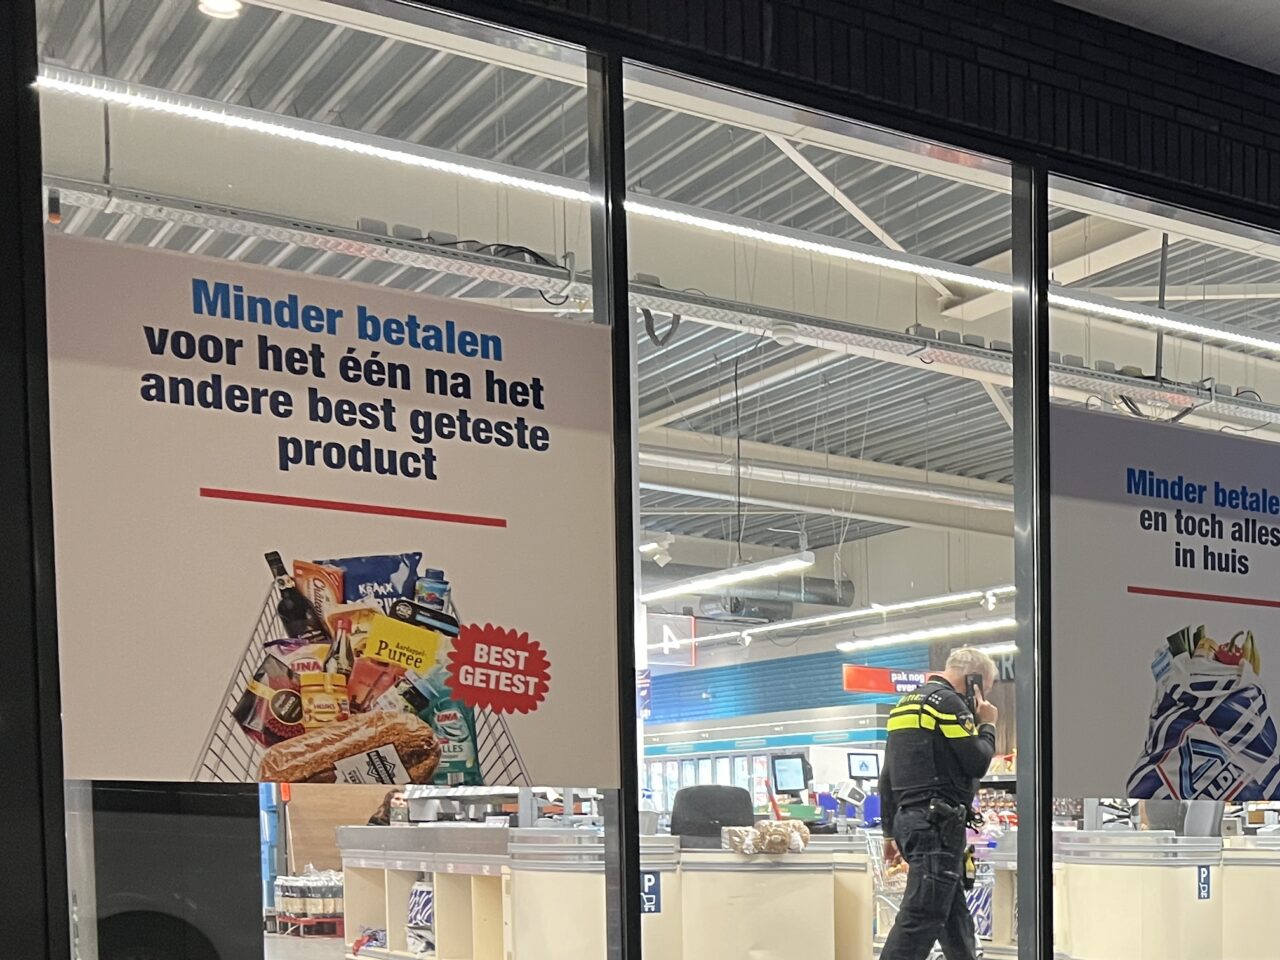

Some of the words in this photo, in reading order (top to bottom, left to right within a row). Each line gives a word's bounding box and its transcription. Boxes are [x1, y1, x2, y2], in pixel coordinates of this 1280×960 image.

[191, 278, 343, 335] Minder
[357, 305, 503, 361] betalen
[142, 325, 243, 366] voor
[258, 335, 325, 379] het
[339, 346, 411, 391] één
[425, 369, 471, 399] na
[486, 370, 544, 410] het
[140, 372, 293, 418] andere
[308, 388, 396, 432] best
[410, 409, 550, 452] geteste
[278, 436, 438, 480] product
[1126, 468, 1207, 504] Minder
[1140, 509, 1167, 532] en
[1175, 509, 1223, 540] toch
[1231, 518, 1280, 547] alles
[1175, 542, 1195, 569] in
[1203, 545, 1249, 575] huis
[375, 639, 423, 669] Puree
[474, 643, 529, 670] BEST
[459, 664, 539, 696] GETEST
[891, 671, 908, 683] pak
[909, 673, 925, 684] nog
[644, 874, 656, 893] P
[1201, 867, 1208, 884] P
